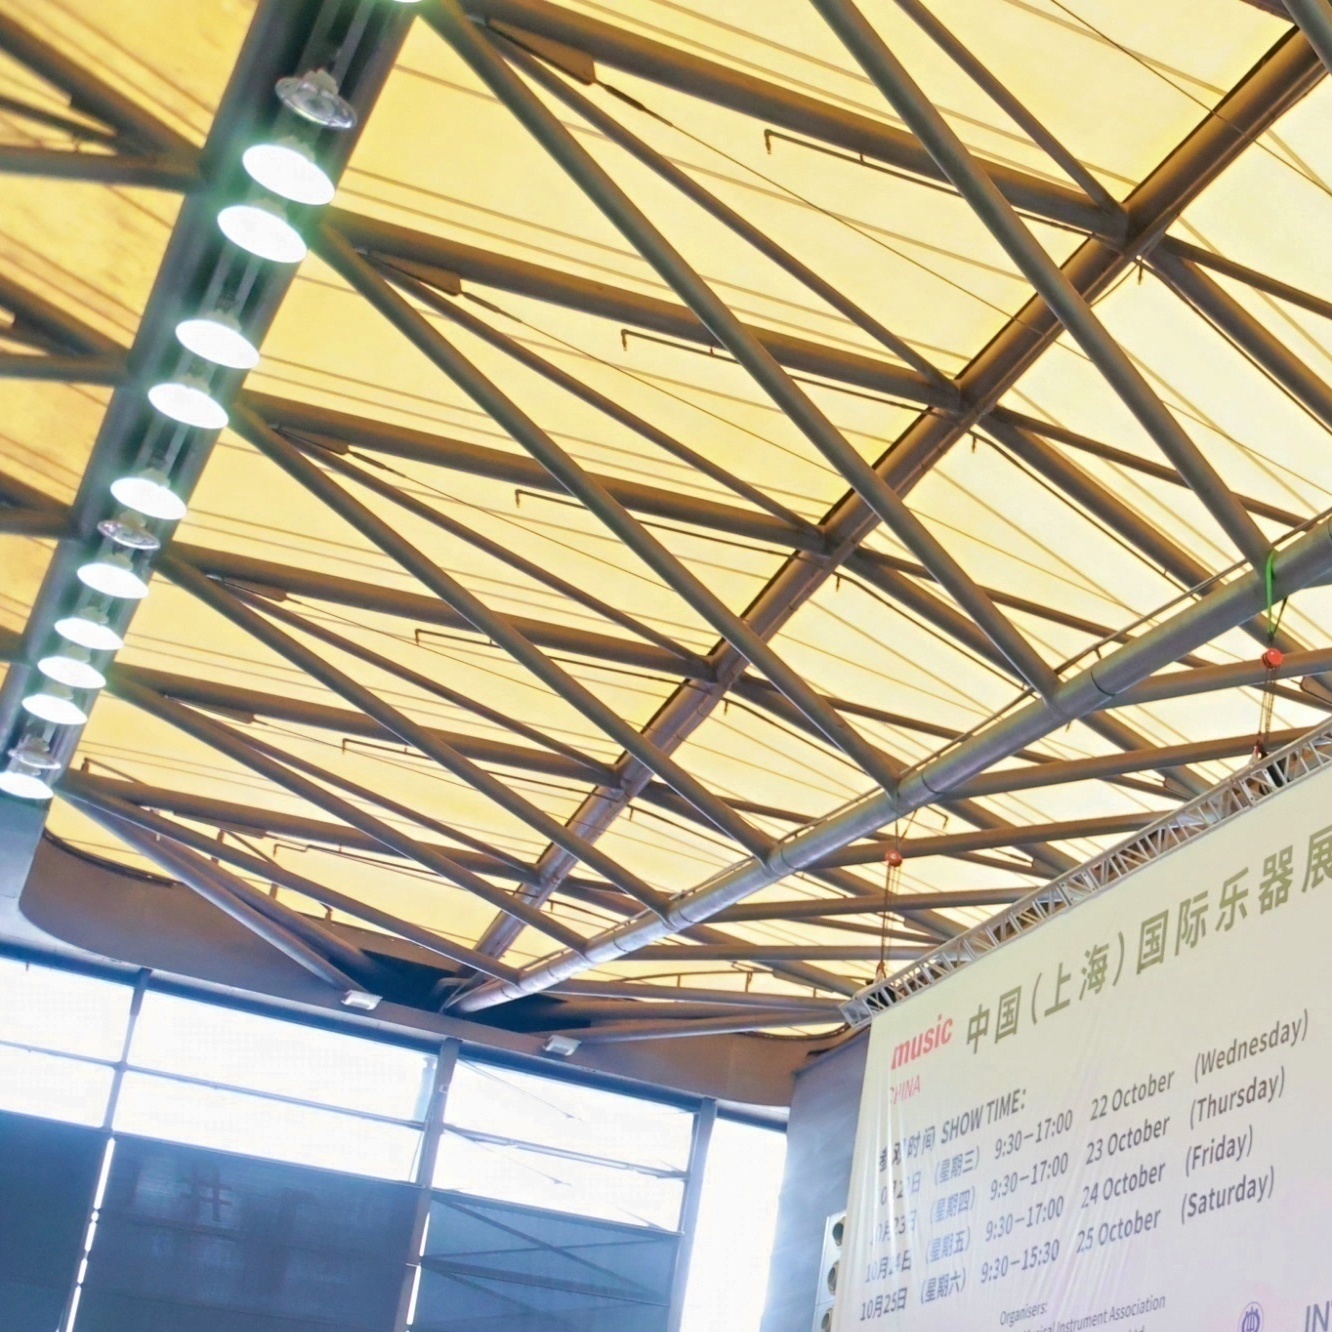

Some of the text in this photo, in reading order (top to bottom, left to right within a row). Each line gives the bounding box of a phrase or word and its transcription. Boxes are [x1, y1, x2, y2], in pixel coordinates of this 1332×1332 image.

[890, 1013, 953, 1070] music
[1090, 1096, 1109, 1121] 22
[1112, 1070, 1175, 1112] October
[1193, 1009, 1309, 1083] (Wednesday)
[941, 1105, 984, 1144] SHOW
[1086, 1139, 1103, 1165] 23
[1107, 1115, 1170, 1156] October
[1190, 1066, 1285, 1130] (Thursday)
[1081, 1182, 1099, 1209] 24
[1103, 1161, 1166, 1201] October
[1185, 1124, 1252, 1178] (Friday)
[860, 1287, 908, 1321] 10月25日
[1077, 1227, 1094, 1254] 25
[1098, 1208, 1161, 1246] October
[1181, 1165, 1275, 1225] (Saturday)
[1000, 1302, 1048, 1328] Organisers:
[1109, 1295, 1166, 1324] Association
